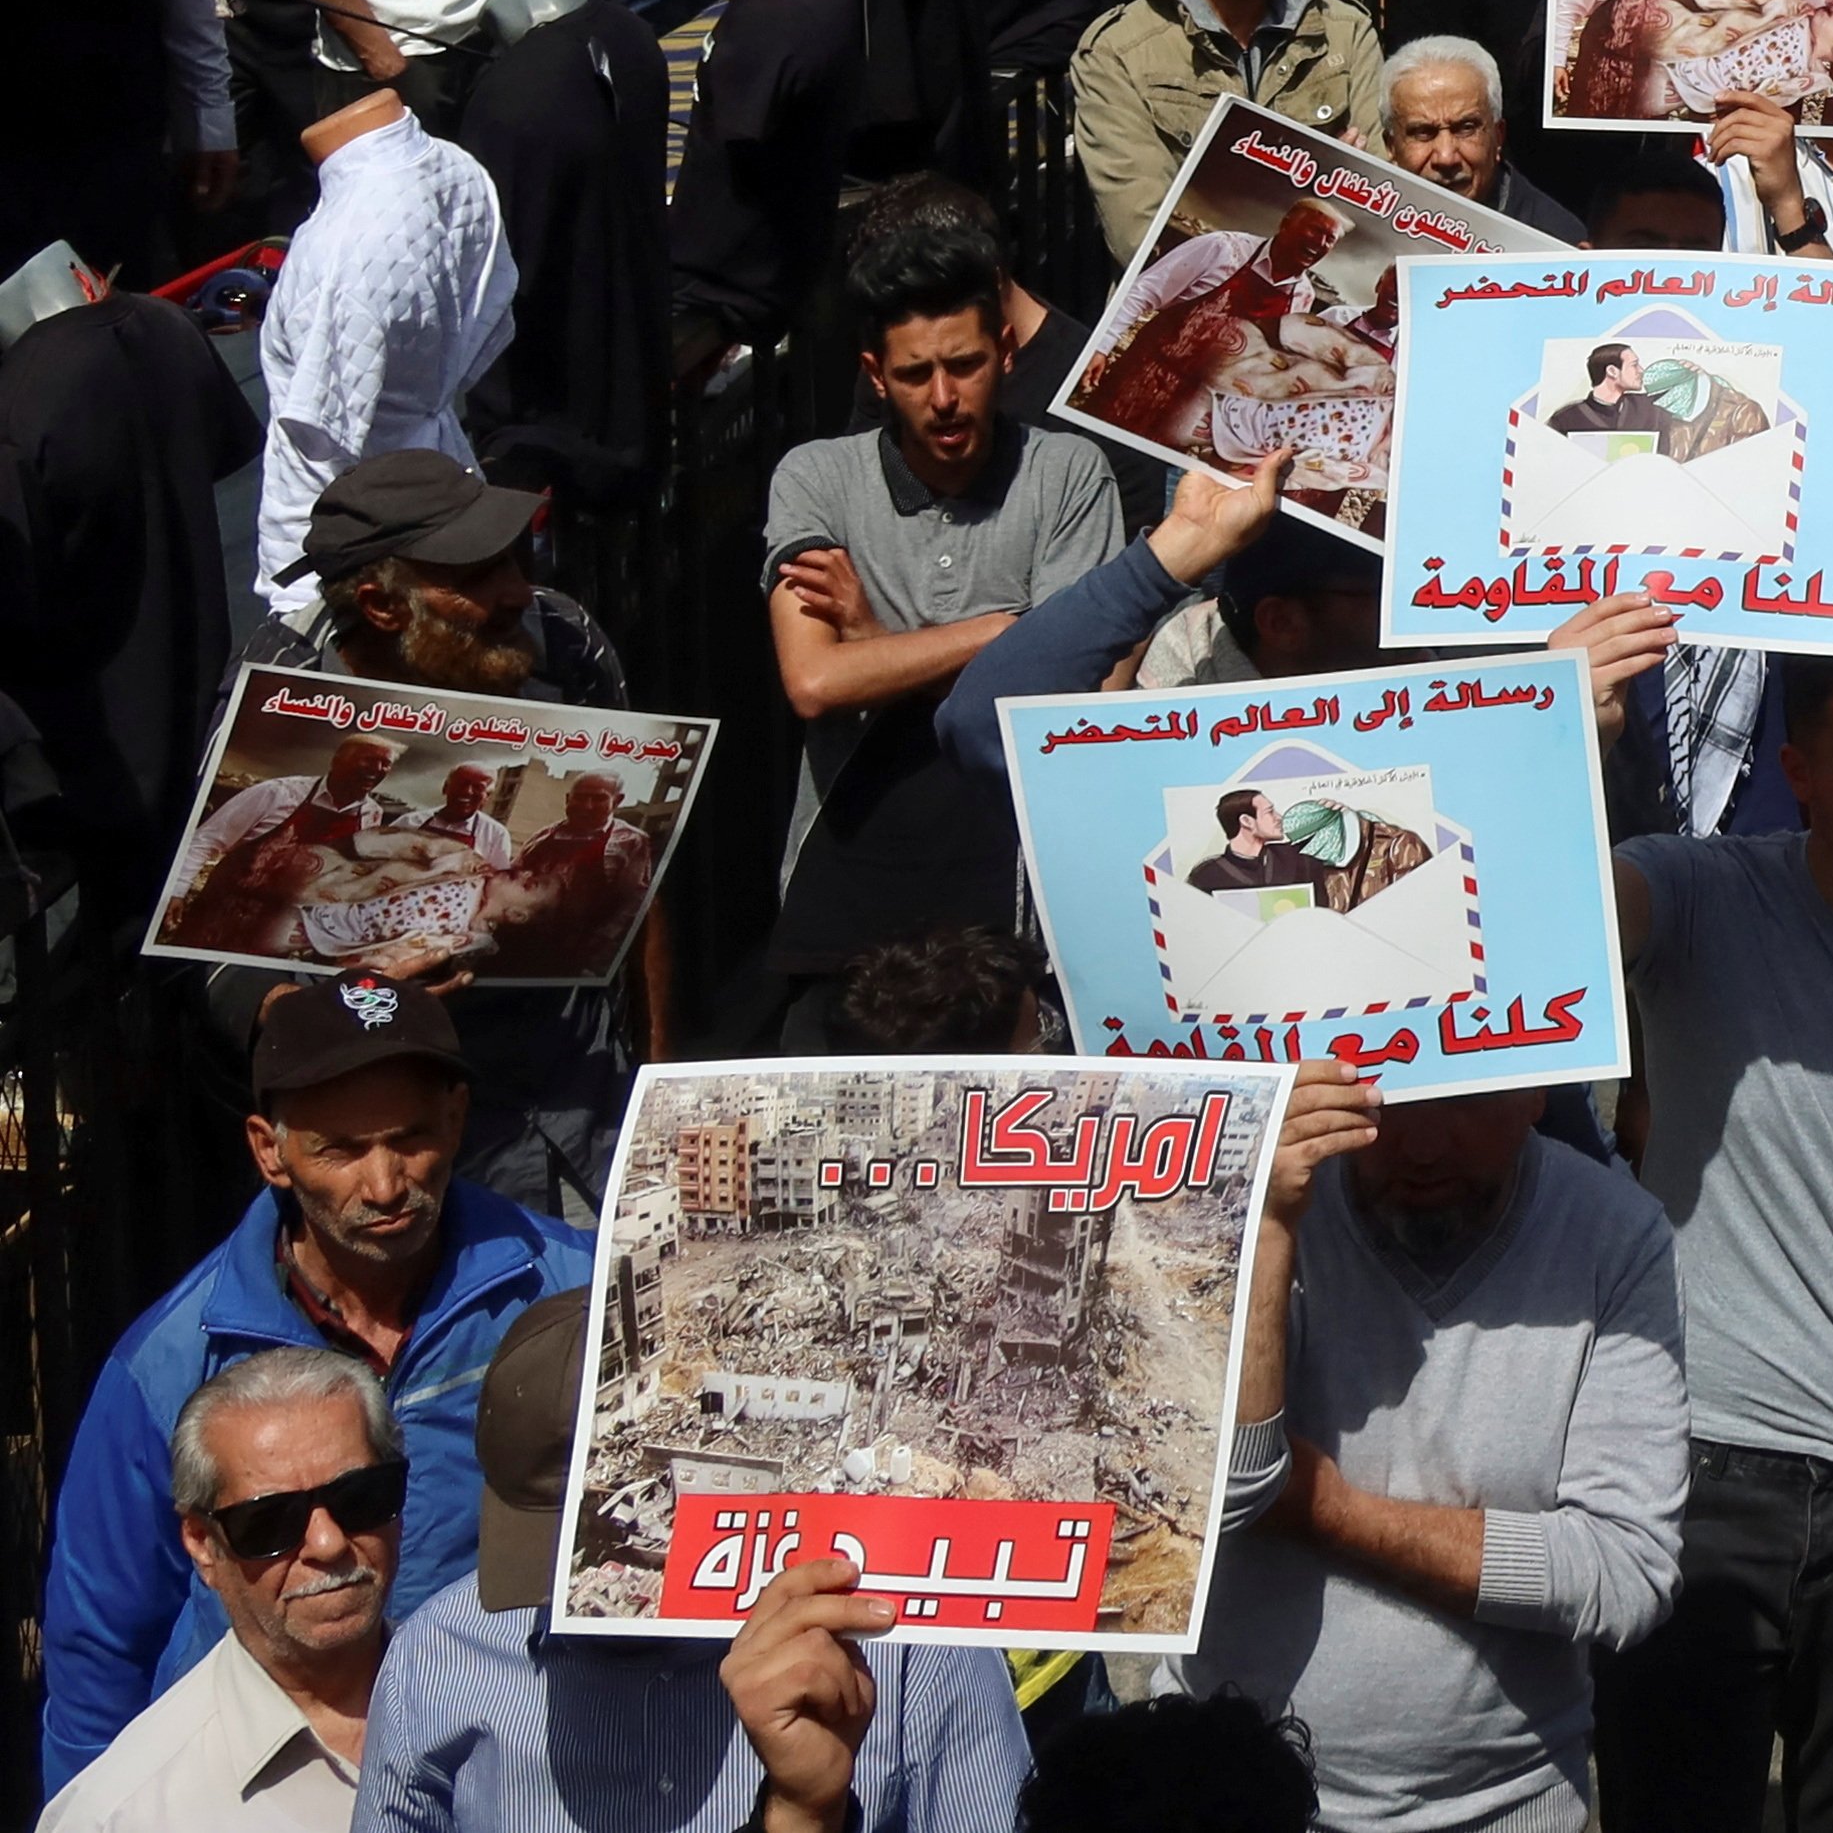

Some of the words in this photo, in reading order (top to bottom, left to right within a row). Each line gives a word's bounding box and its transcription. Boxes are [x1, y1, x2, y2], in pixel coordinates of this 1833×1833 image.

[1228, 128, 1318, 191] والنساء
[1314, 162, 1398, 221] الأطفال
[1390, 202, 1474, 257] يقتلون
[1434, 268, 1591, 310] المتحضر
[1594, 268, 1716, 305] العالم
[1722, 275, 1779, 313] إلى
[261, 685, 354, 730] والنساء
[355, 694, 444, 740] الأطفال
[1208, 697, 1342, 740] العالم
[1353, 691, 1414, 734] إلى
[1424, 676, 1555, 721] رسالة
[446, 709, 531, 751] يقتلون
[531, 722, 594, 758] حرب
[596, 728, 685, 767] مجرموا
[1038, 710, 1199, 757] المتحضر
[957, 1086, 1231, 1215] امريكا
[825, 1517, 1092, 1618] تبيد
